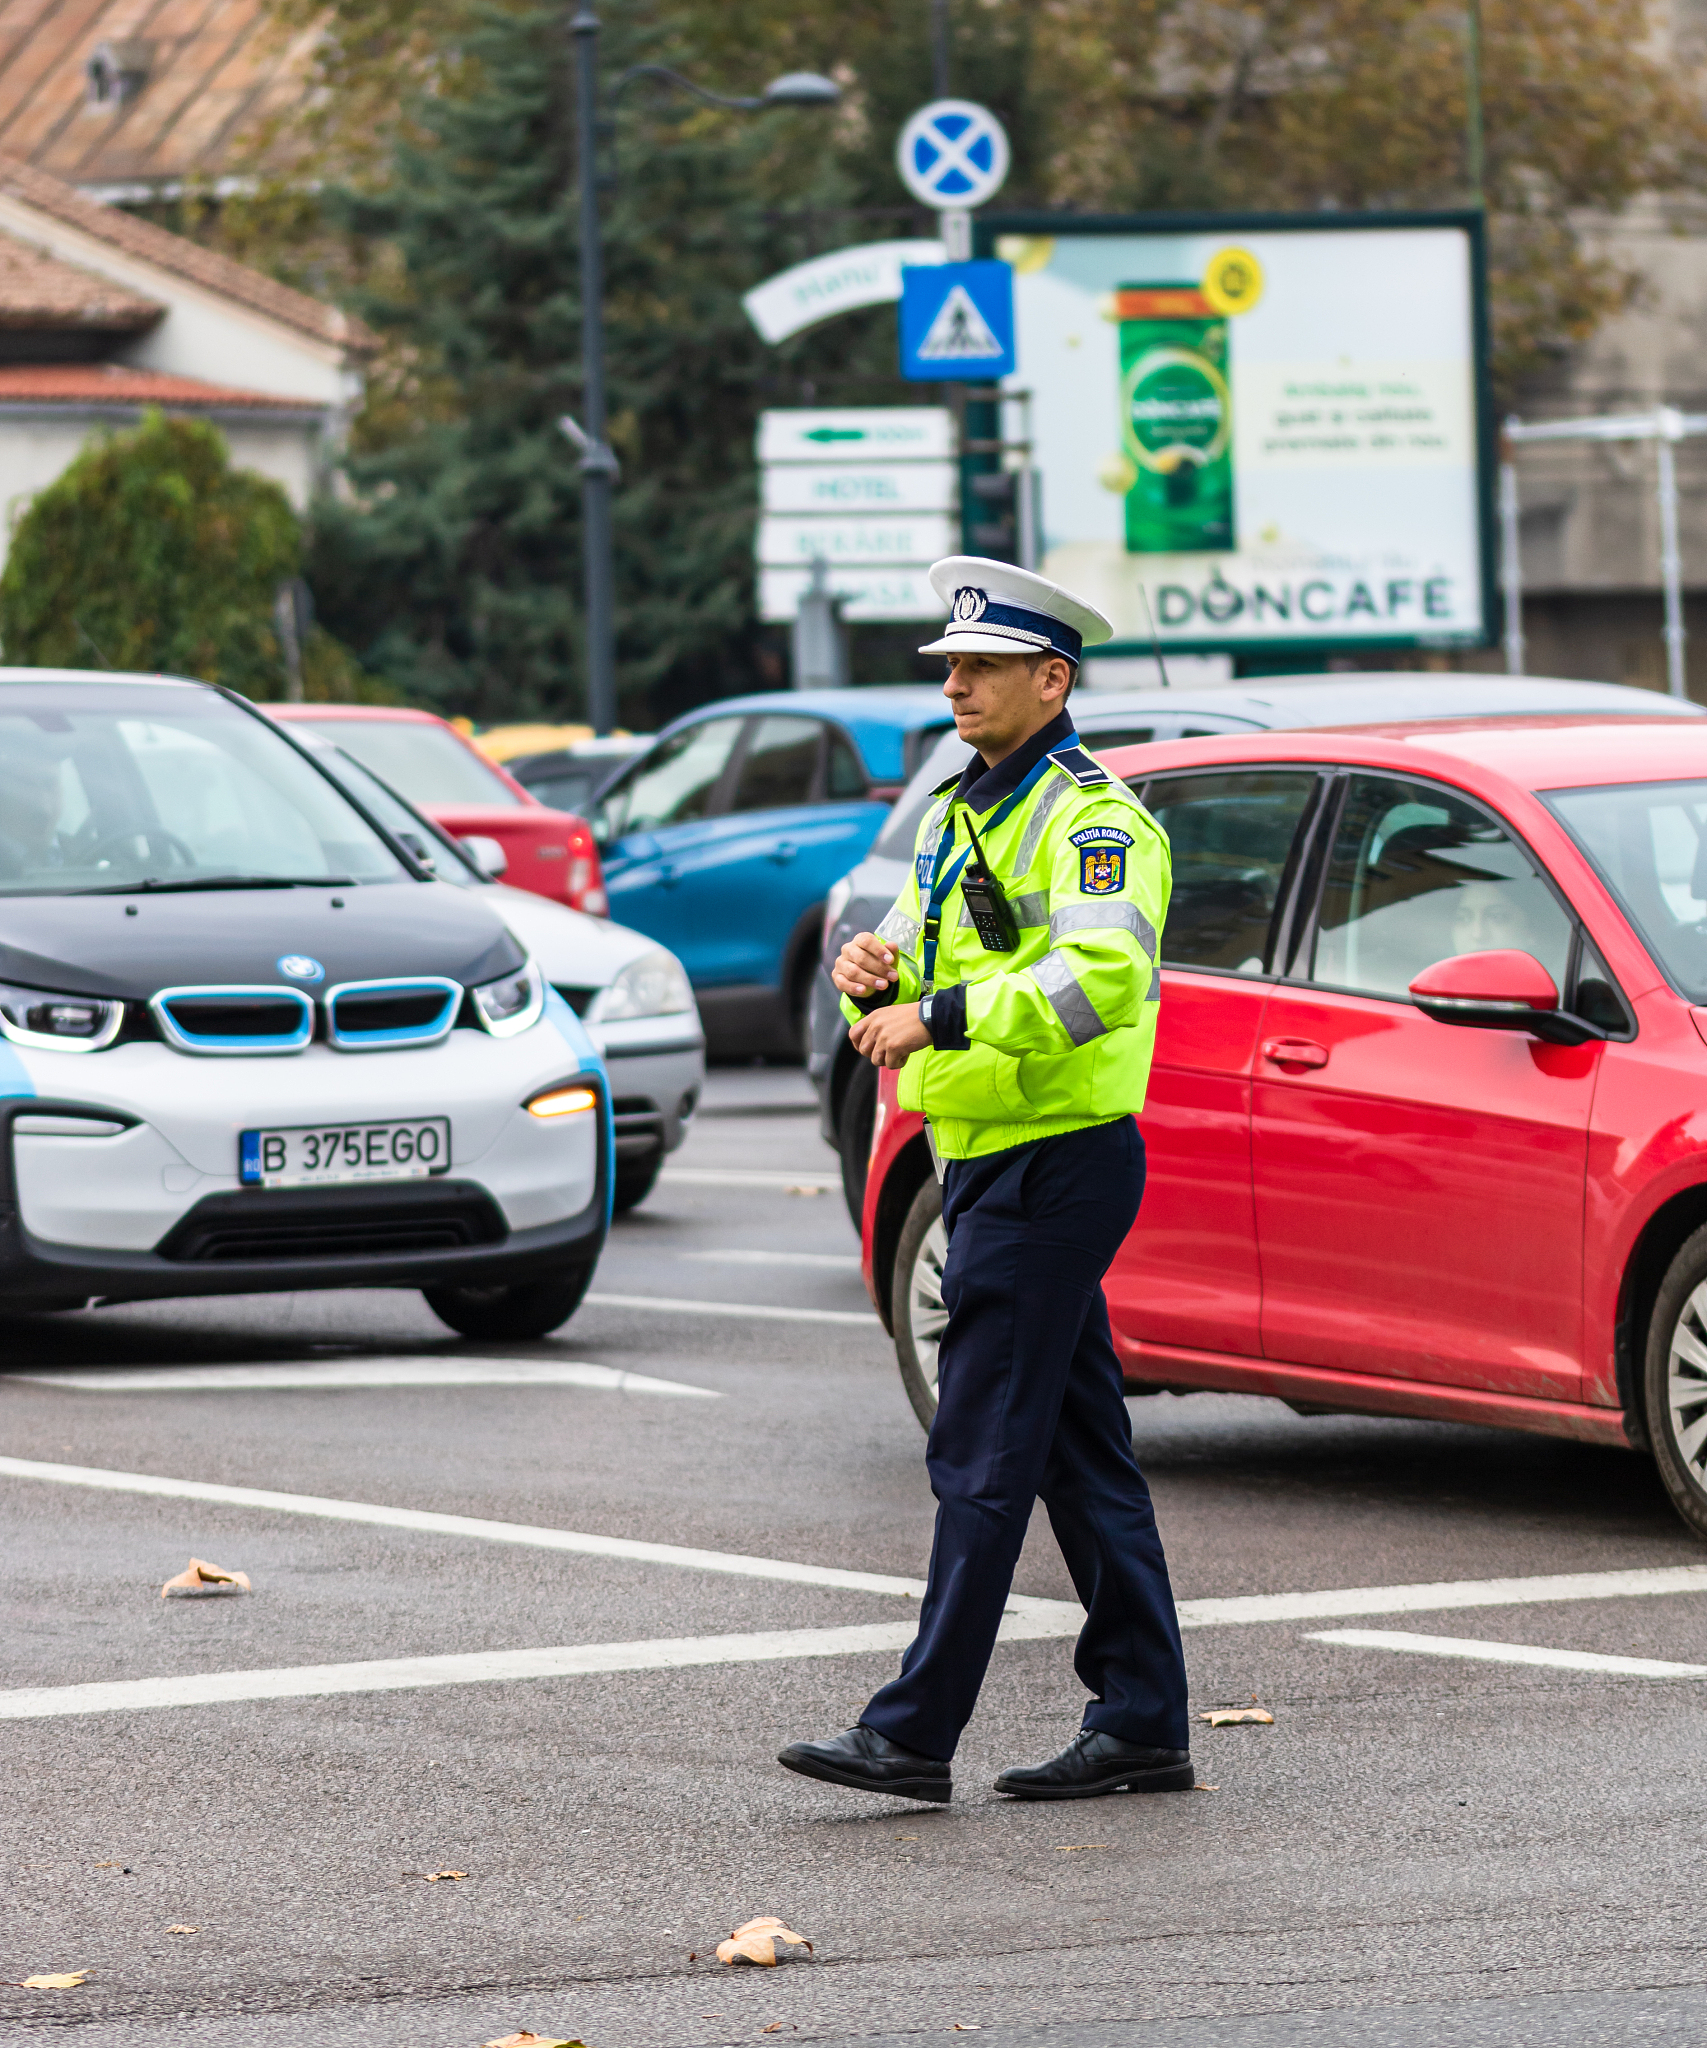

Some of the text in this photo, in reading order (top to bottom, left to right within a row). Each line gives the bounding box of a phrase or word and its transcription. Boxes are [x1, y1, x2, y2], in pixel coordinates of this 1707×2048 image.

[813, 476, 899, 501] HOTEL
[263, 1126, 440, 1172] B 375EGO
